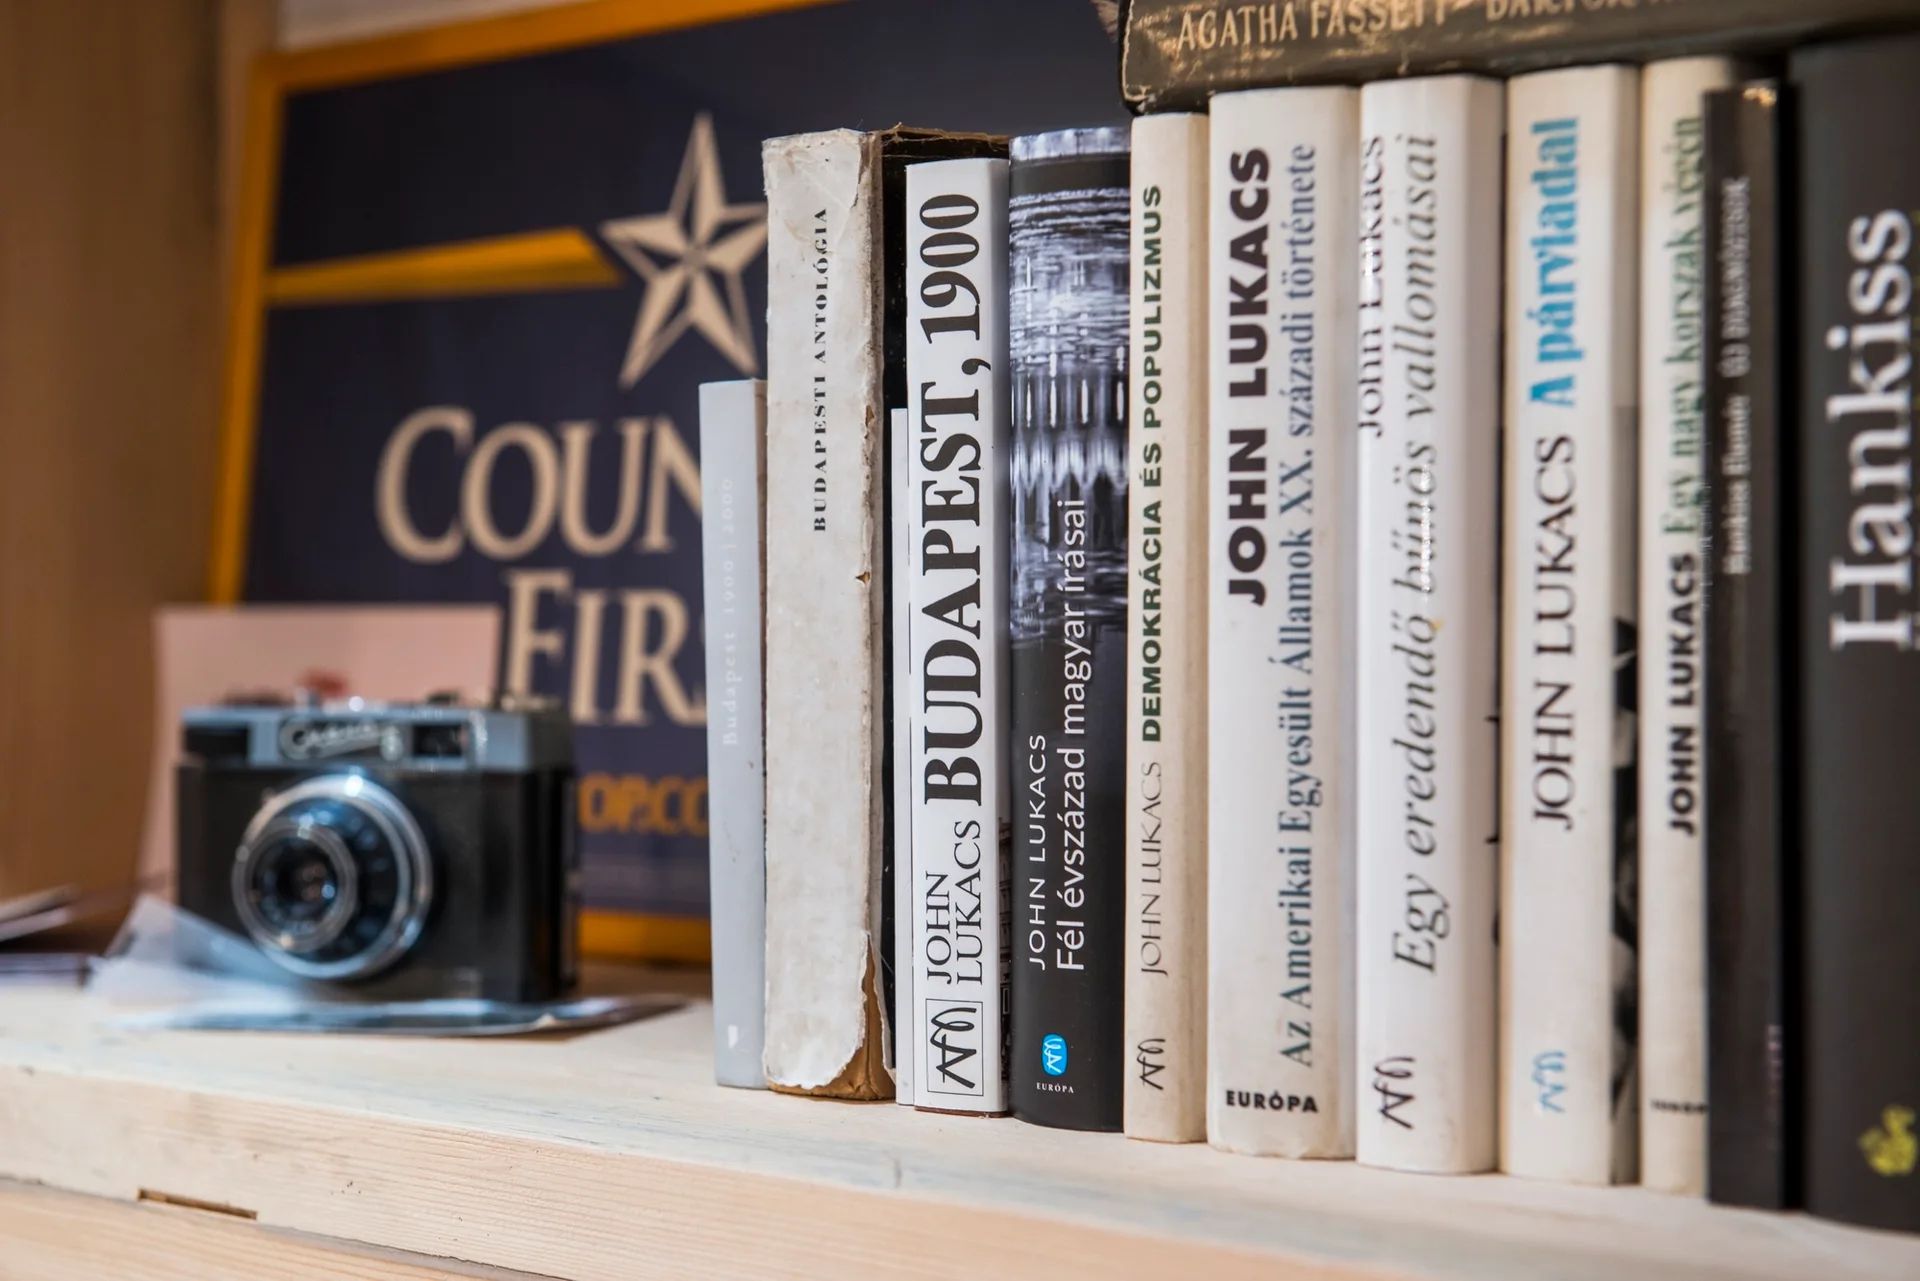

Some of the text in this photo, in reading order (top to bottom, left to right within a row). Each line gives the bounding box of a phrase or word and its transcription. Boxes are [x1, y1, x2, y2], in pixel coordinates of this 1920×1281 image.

[1177, 3, 1298, 50] AGATHA
[1358, 134, 1385, 439] John Lukacs
[1662, 226, 1702, 366] korszak
[812, 207, 829, 532] BUDAPESTI ANTOLÓGIA
[1228, 147, 1270, 607] JOHN LUKACS
[1669, 379, 1704, 457] nagy
[1826, 209, 1914, 651] Hankiss
[720, 476, 735, 535] 2000
[919, 194, 991, 806] BUDAPEST, 1900
[1390, 133, 1450, 974] Egy eredendő bűnös vallomásai
[1526, 116, 1586, 831] JOHN LUKACS A párviadal
[1662, 474, 1704, 537] Egy
[504, 566, 708, 727] FIR
[723, 560, 736, 616] 1900
[1138, 185, 1169, 977] JOHN LUKACS DEMOKRÁCIA ÉS POPULIZMUS
[1268, 144, 1322, 1067] Az Amerikai Egyesült Államok XX. századi története
[1668, 552, 1697, 708] LUKACS
[722, 630, 741, 746] Budapest
[1054, 498, 1094, 970] Fél évszázad magyar írásai
[1028, 734, 1047, 970] JOHN LUKACS
[1667, 725, 1697, 838] JOHN
[925, 871, 952, 985] JOHN
[953, 820, 983, 985] LUKACS
[1036, 1082, 1075, 1094] EURÓPA
[1226, 1090, 1319, 1113] EURÓPA
